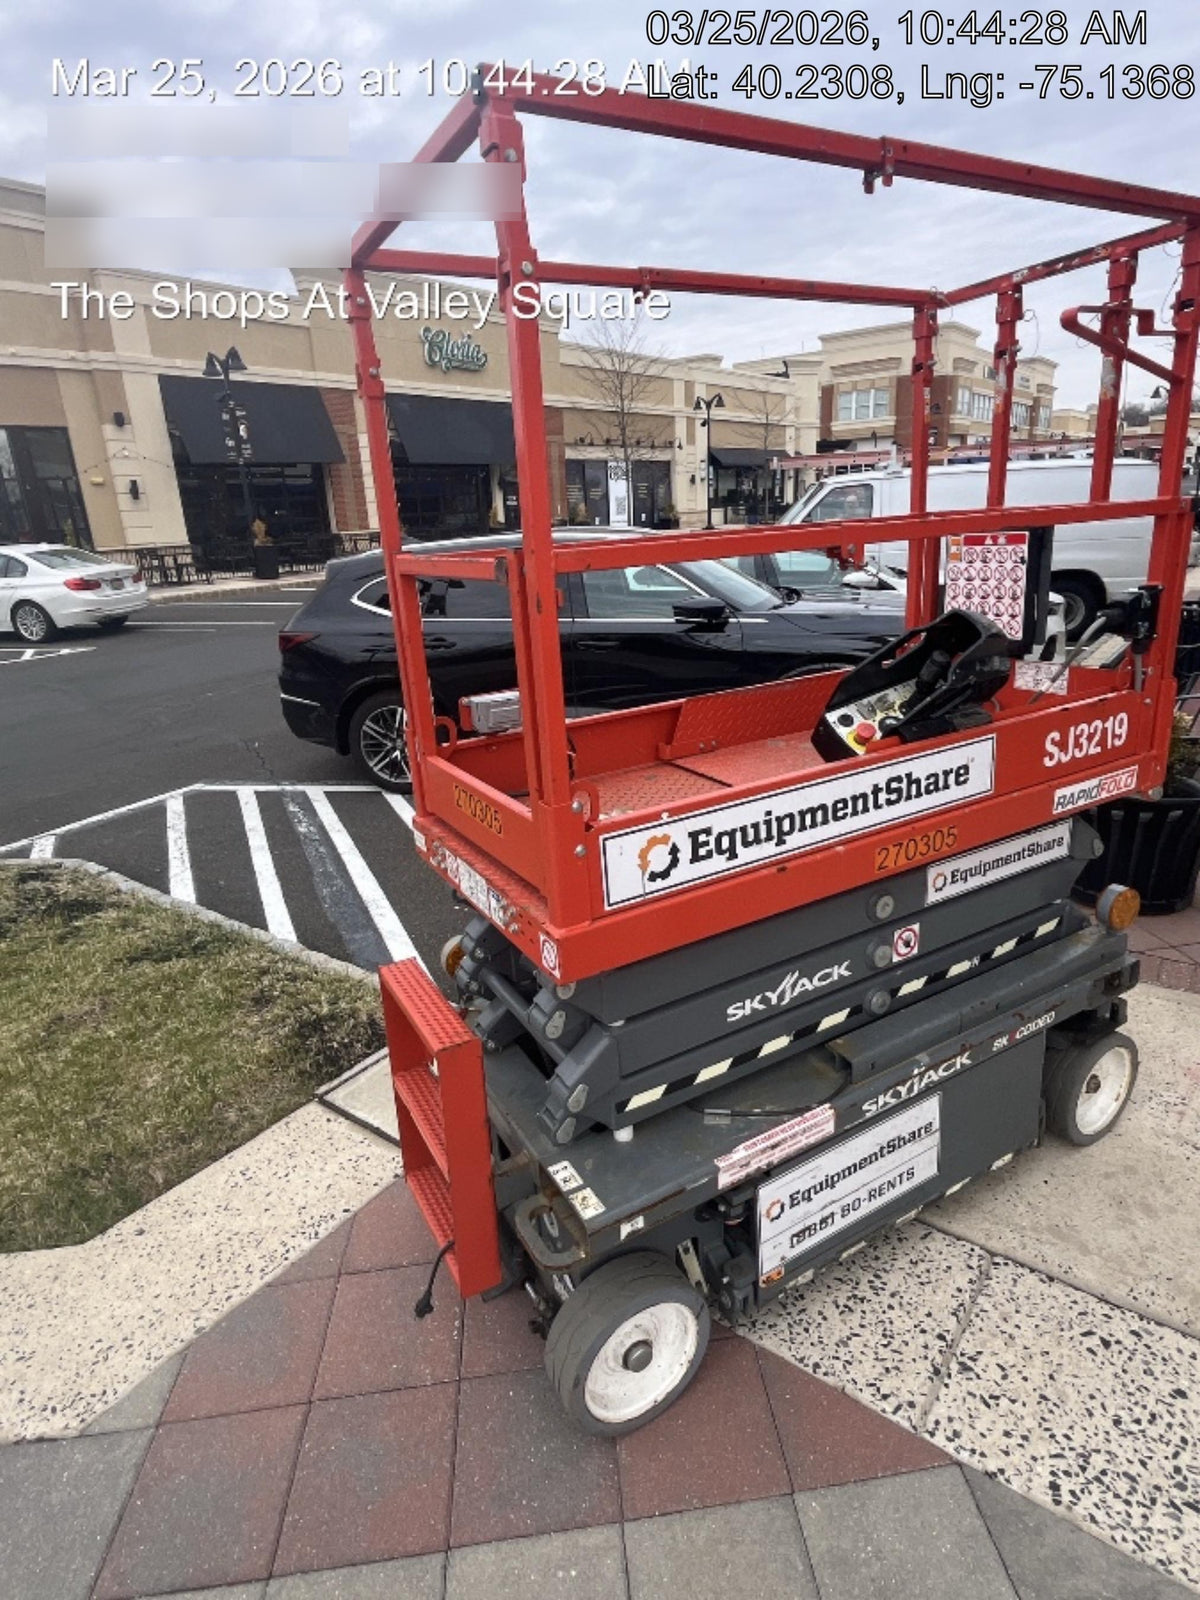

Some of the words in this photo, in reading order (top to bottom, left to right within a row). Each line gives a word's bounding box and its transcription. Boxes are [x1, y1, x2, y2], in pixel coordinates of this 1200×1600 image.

[1043, 712, 1129, 767] SJ3219
[454, 785, 503, 835] 270305
[687, 763, 970, 865] EquipmentShare
[876, 824, 957, 873] 270305
[949, 834, 1065, 885] EquipmentShare
[726, 960, 852, 1022] SKYJACK
[861, 1050, 972, 1119] SKYJACK
[788, 1121, 934, 1210] EquipmentShare
